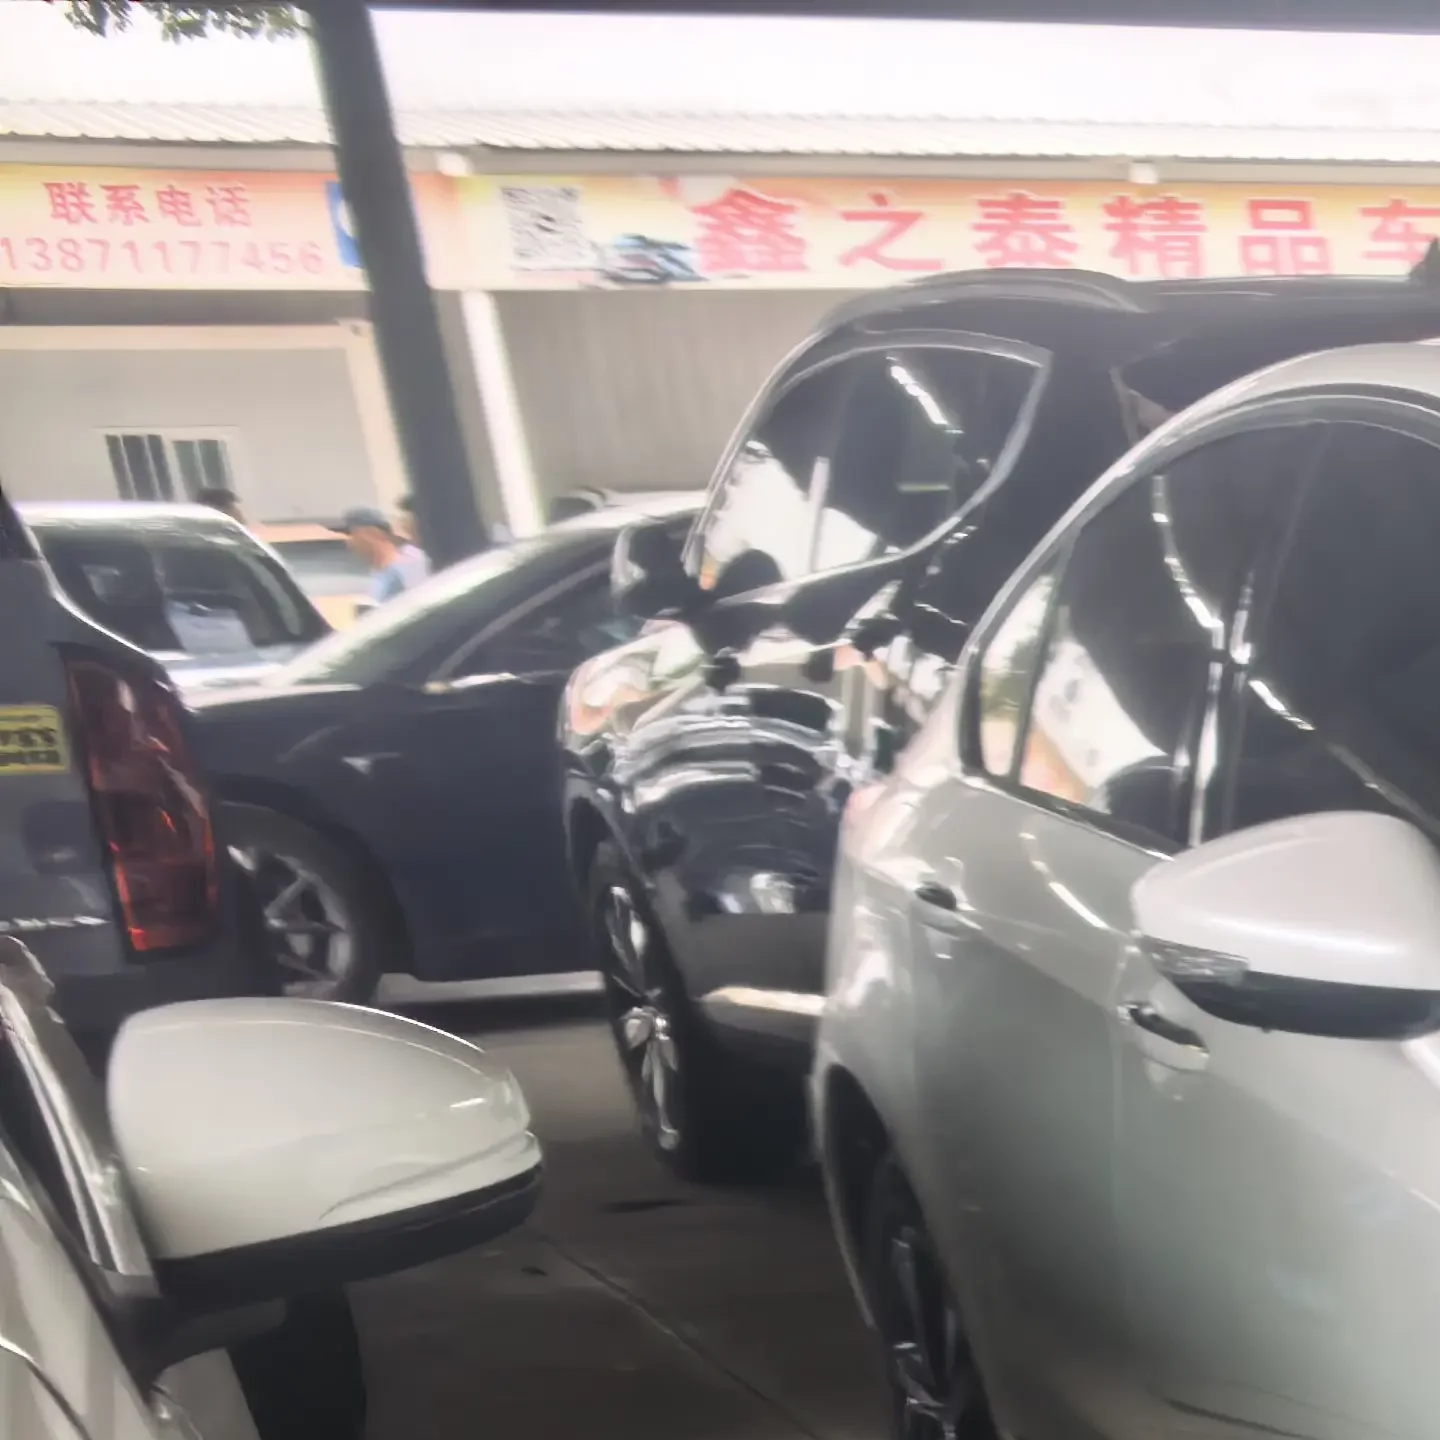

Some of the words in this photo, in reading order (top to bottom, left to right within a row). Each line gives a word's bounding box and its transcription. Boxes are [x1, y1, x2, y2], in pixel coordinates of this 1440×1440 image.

[43, 181, 253, 227] 联系电话
[0, 236, 325, 275] 13871177456
